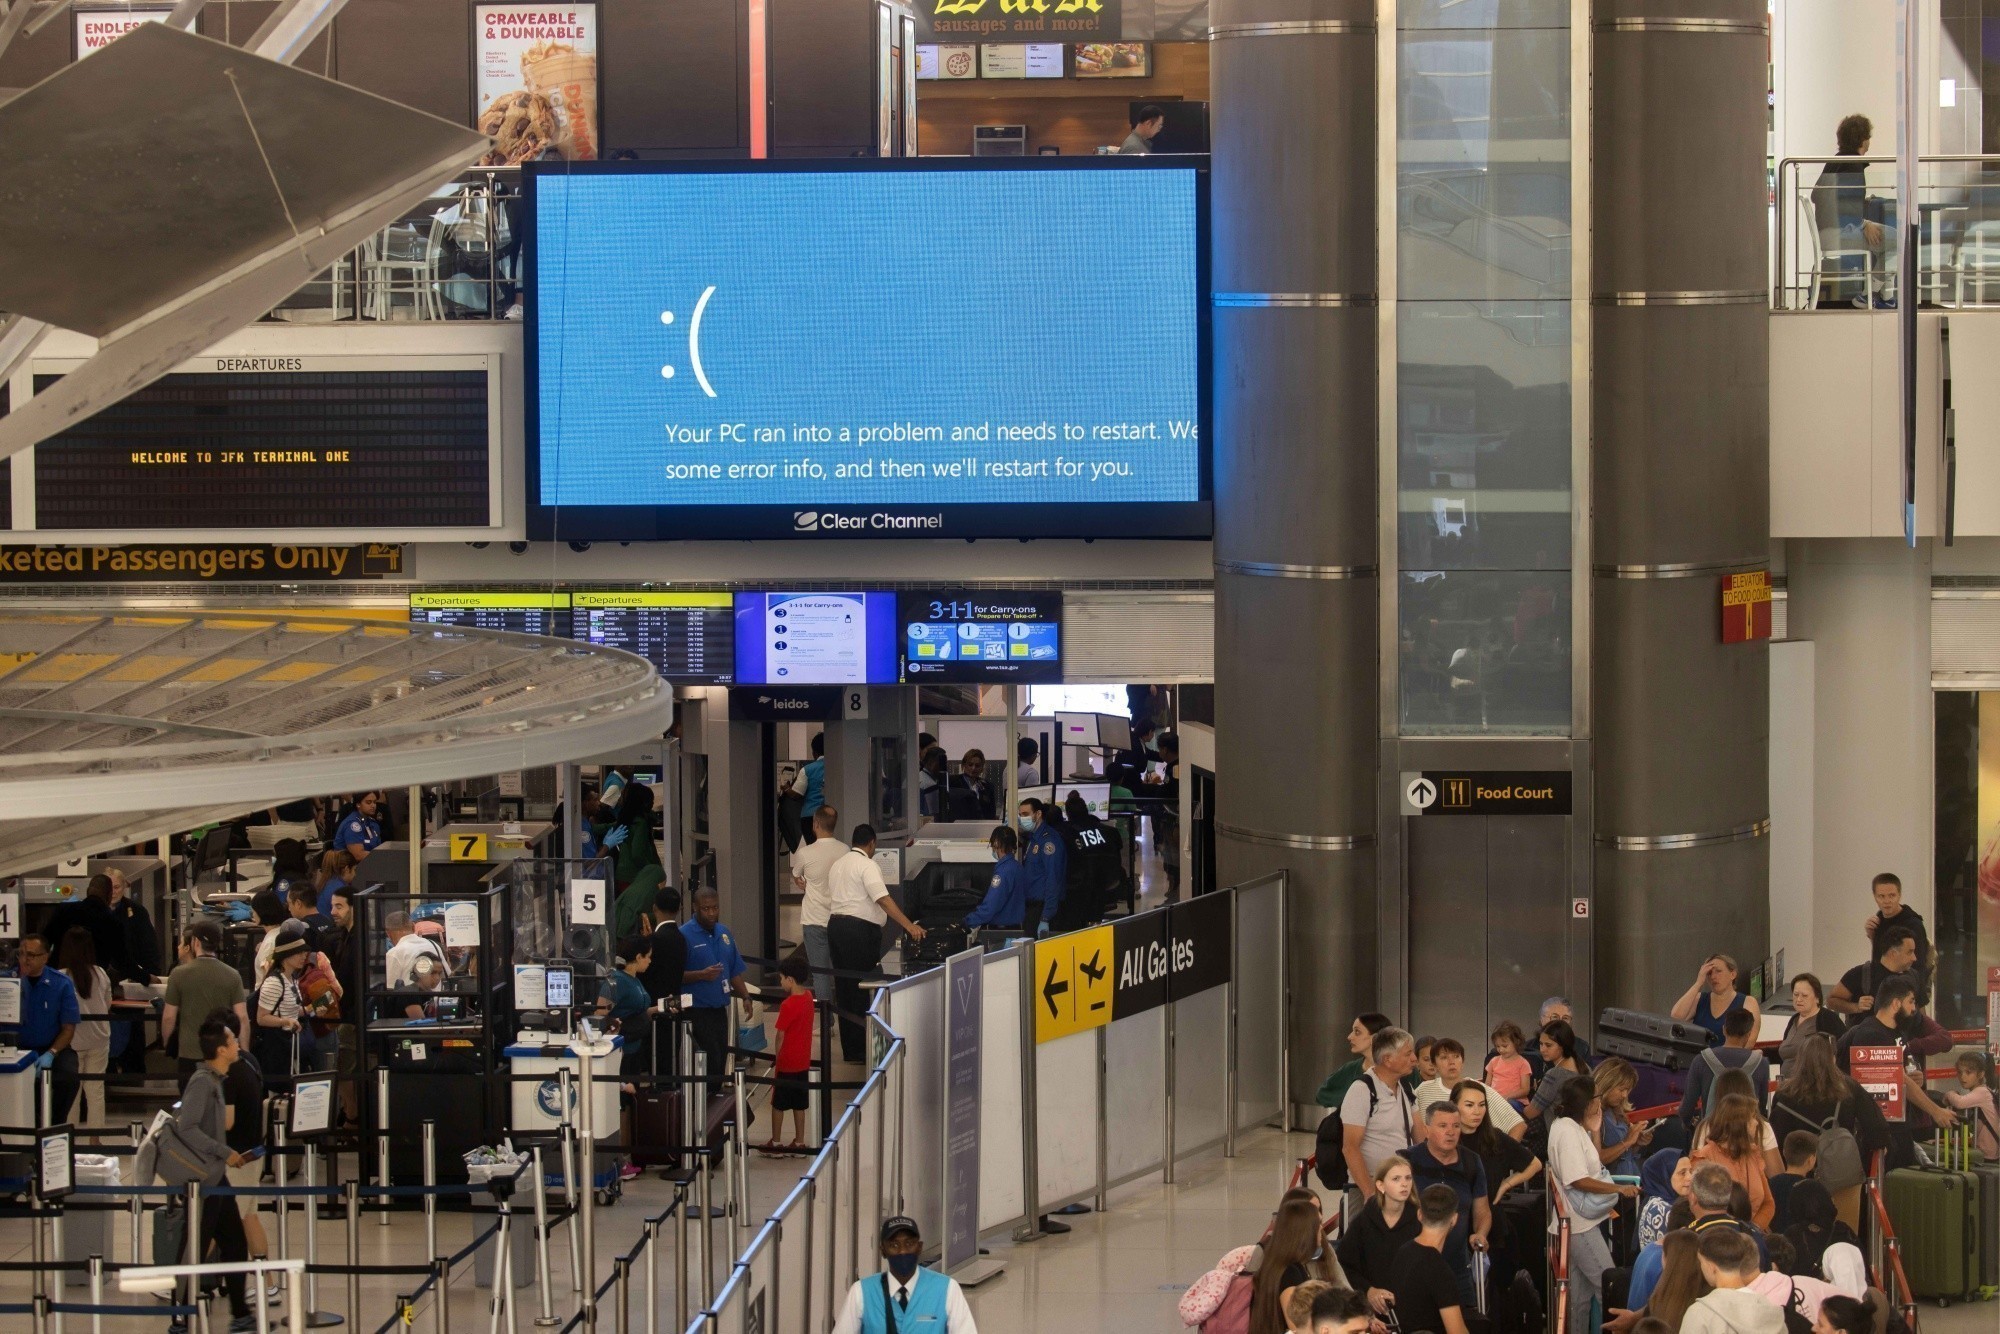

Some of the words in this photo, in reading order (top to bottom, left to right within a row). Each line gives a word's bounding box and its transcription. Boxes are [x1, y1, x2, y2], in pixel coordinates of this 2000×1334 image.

[485, 13, 577, 25] CRAVEABLE
[934, 17, 1007, 36] sausages
[1014, 16, 1045, 31] and
[1052, 16, 1099, 31] more!
[486, 28, 496, 39] &
[501, 27, 585, 39] DUNKABLE
[217, 358, 302, 370] DEPARTURES
[666, 424, 712, 443] Your
[720, 424, 745, 442] PC
[754, 427, 785, 442] ran
[793, 423, 831, 441] into
[839, 427, 850, 441] a
[858, 422, 942, 445] problem
[952, 422, 988, 440] and
[998, 421, 1056, 440] needs
[1063, 423, 1084, 440] to
[1093, 422, 1160, 440] restart.
[132, 453, 188, 463] WELCOME
[197, 453, 212, 463] TO
[221, 452, 244, 462] JFK
[254, 451, 316, 462] TERMINAL
[326, 451, 349, 462] ONE
[666, 464, 720, 479] some
[728, 463, 776, 478] error
[784, 458, 826, 480] info,
[836, 459, 872, 478] and
[880, 458, 925, 477] then
[933, 458, 976, 477] we'll
[985, 459, 1048, 476] restart
[1055, 457, 1084, 476] for
[1091, 462, 1134, 481] you.
[821, 513, 867, 529] Clear
[871, 513, 942, 528] Channel
[93, 547, 265, 576] Passengers
[275, 546, 348, 575] Only
[1733, 574, 1764, 588] ELEVATOR
[427, 597, 480, 605] Departures
[589, 596, 643, 604] Departures
[1724, 592, 1733, 604] TO
[1734, 590, 1751, 602] FOOD
[1752, 587, 1771, 600] COURT
[778, 609, 784, 617] 3
[929, 601, 974, 618] 3-1-1
[991, 606, 1036, 614] Carry-ons
[914, 626, 922, 636] 3
[967, 626, 971, 636] 1
[1017, 626, 1021, 636] 1
[774, 699, 809, 709] leidos
[851, 693, 861, 711] 8
[1477, 787, 1510, 799] Food
[1514, 787, 1553, 798] Court
[1080, 828, 1106, 846] TSA
[459, 836, 478, 857] 7
[583, 894, 596, 911] 5
[1575, 903, 1586, 914] G
[0, 904, 11, 932] 4
[1119, 946, 1144, 989] All
[1148, 937, 1194, 981] Gates
